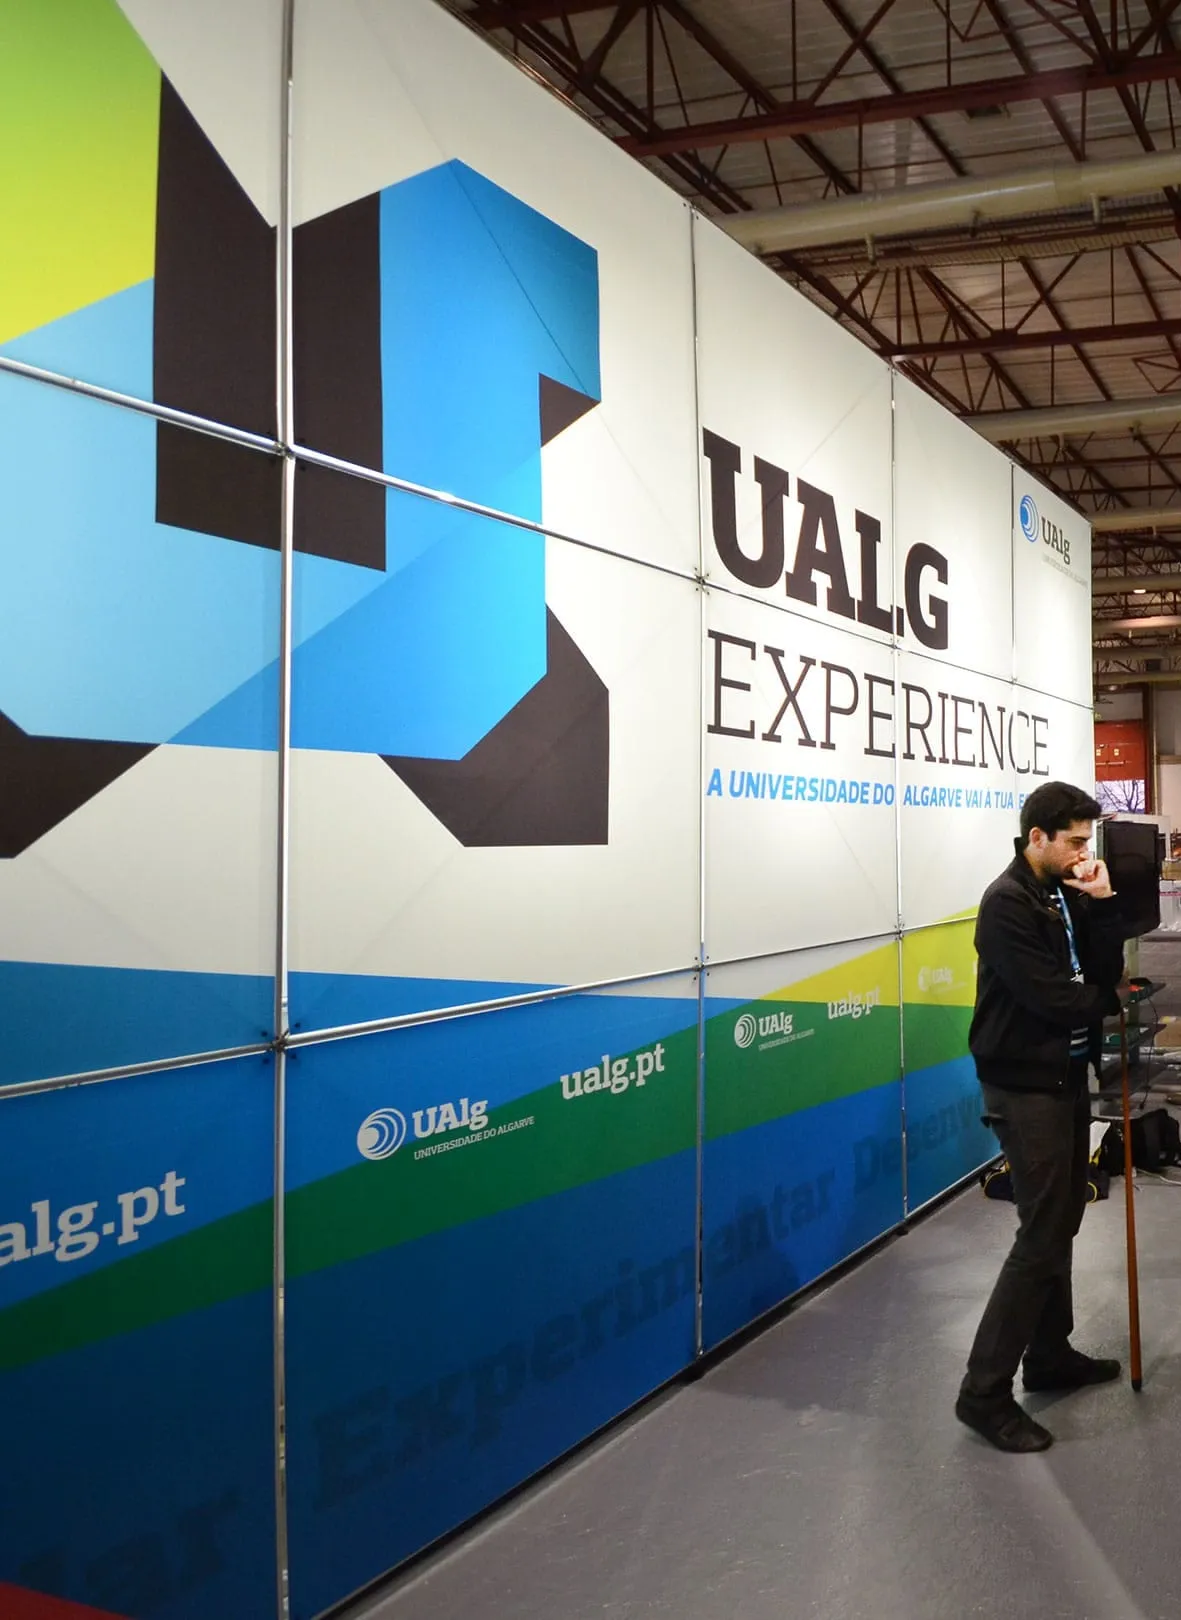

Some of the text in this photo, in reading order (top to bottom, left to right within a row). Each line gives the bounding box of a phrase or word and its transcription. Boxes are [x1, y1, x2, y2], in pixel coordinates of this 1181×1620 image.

[702, 426, 949, 651] UALG
[1041, 516, 1071, 565] UAlg
[706, 629, 1050, 777] EXPERIENCE
[707, 768, 723, 797] A
[729, 770, 871, 806] UNIVERSIDADE
[873, 783, 895, 806] DO
[903, 785, 963, 809] ALGARVE
[965, 788, 983, 809] VAI
[994, 791, 1014, 810] TUA
[758, 1011, 793, 1037] UAlg
[827, 985, 881, 1020] ualg.pt
[560, 1043, 665, 1100] ualg.pt
[412, 1098, 489, 1139] UAlg
[414, 1116, 535, 1160] UNIVERSIDADE DO ALGARVE
